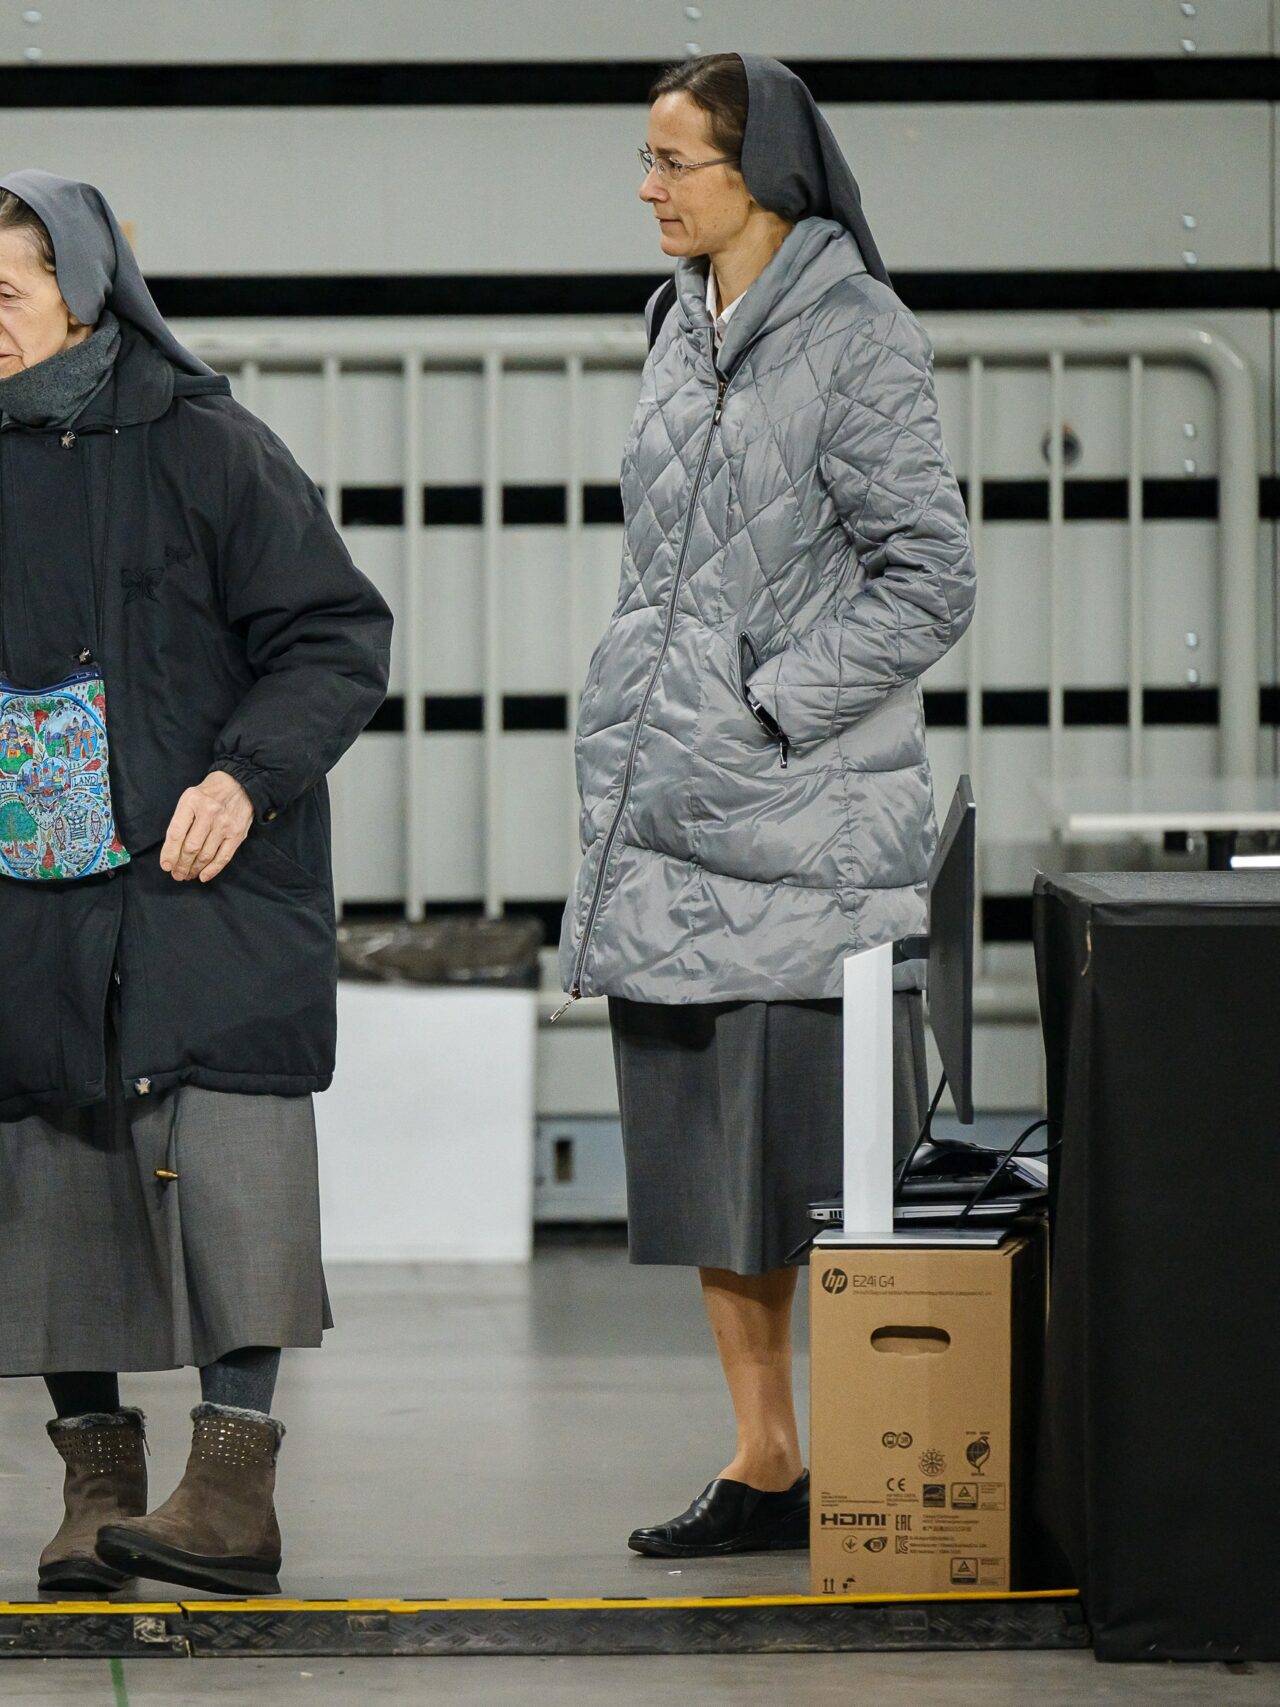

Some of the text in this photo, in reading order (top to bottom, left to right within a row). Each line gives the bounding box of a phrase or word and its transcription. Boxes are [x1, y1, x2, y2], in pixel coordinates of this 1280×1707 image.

[73, 775, 97, 786] LAND
[823, 1268, 847, 1294] hp
[852, 1275, 895, 1288] E24i G4
[821, 1513, 886, 1526] HDMI
